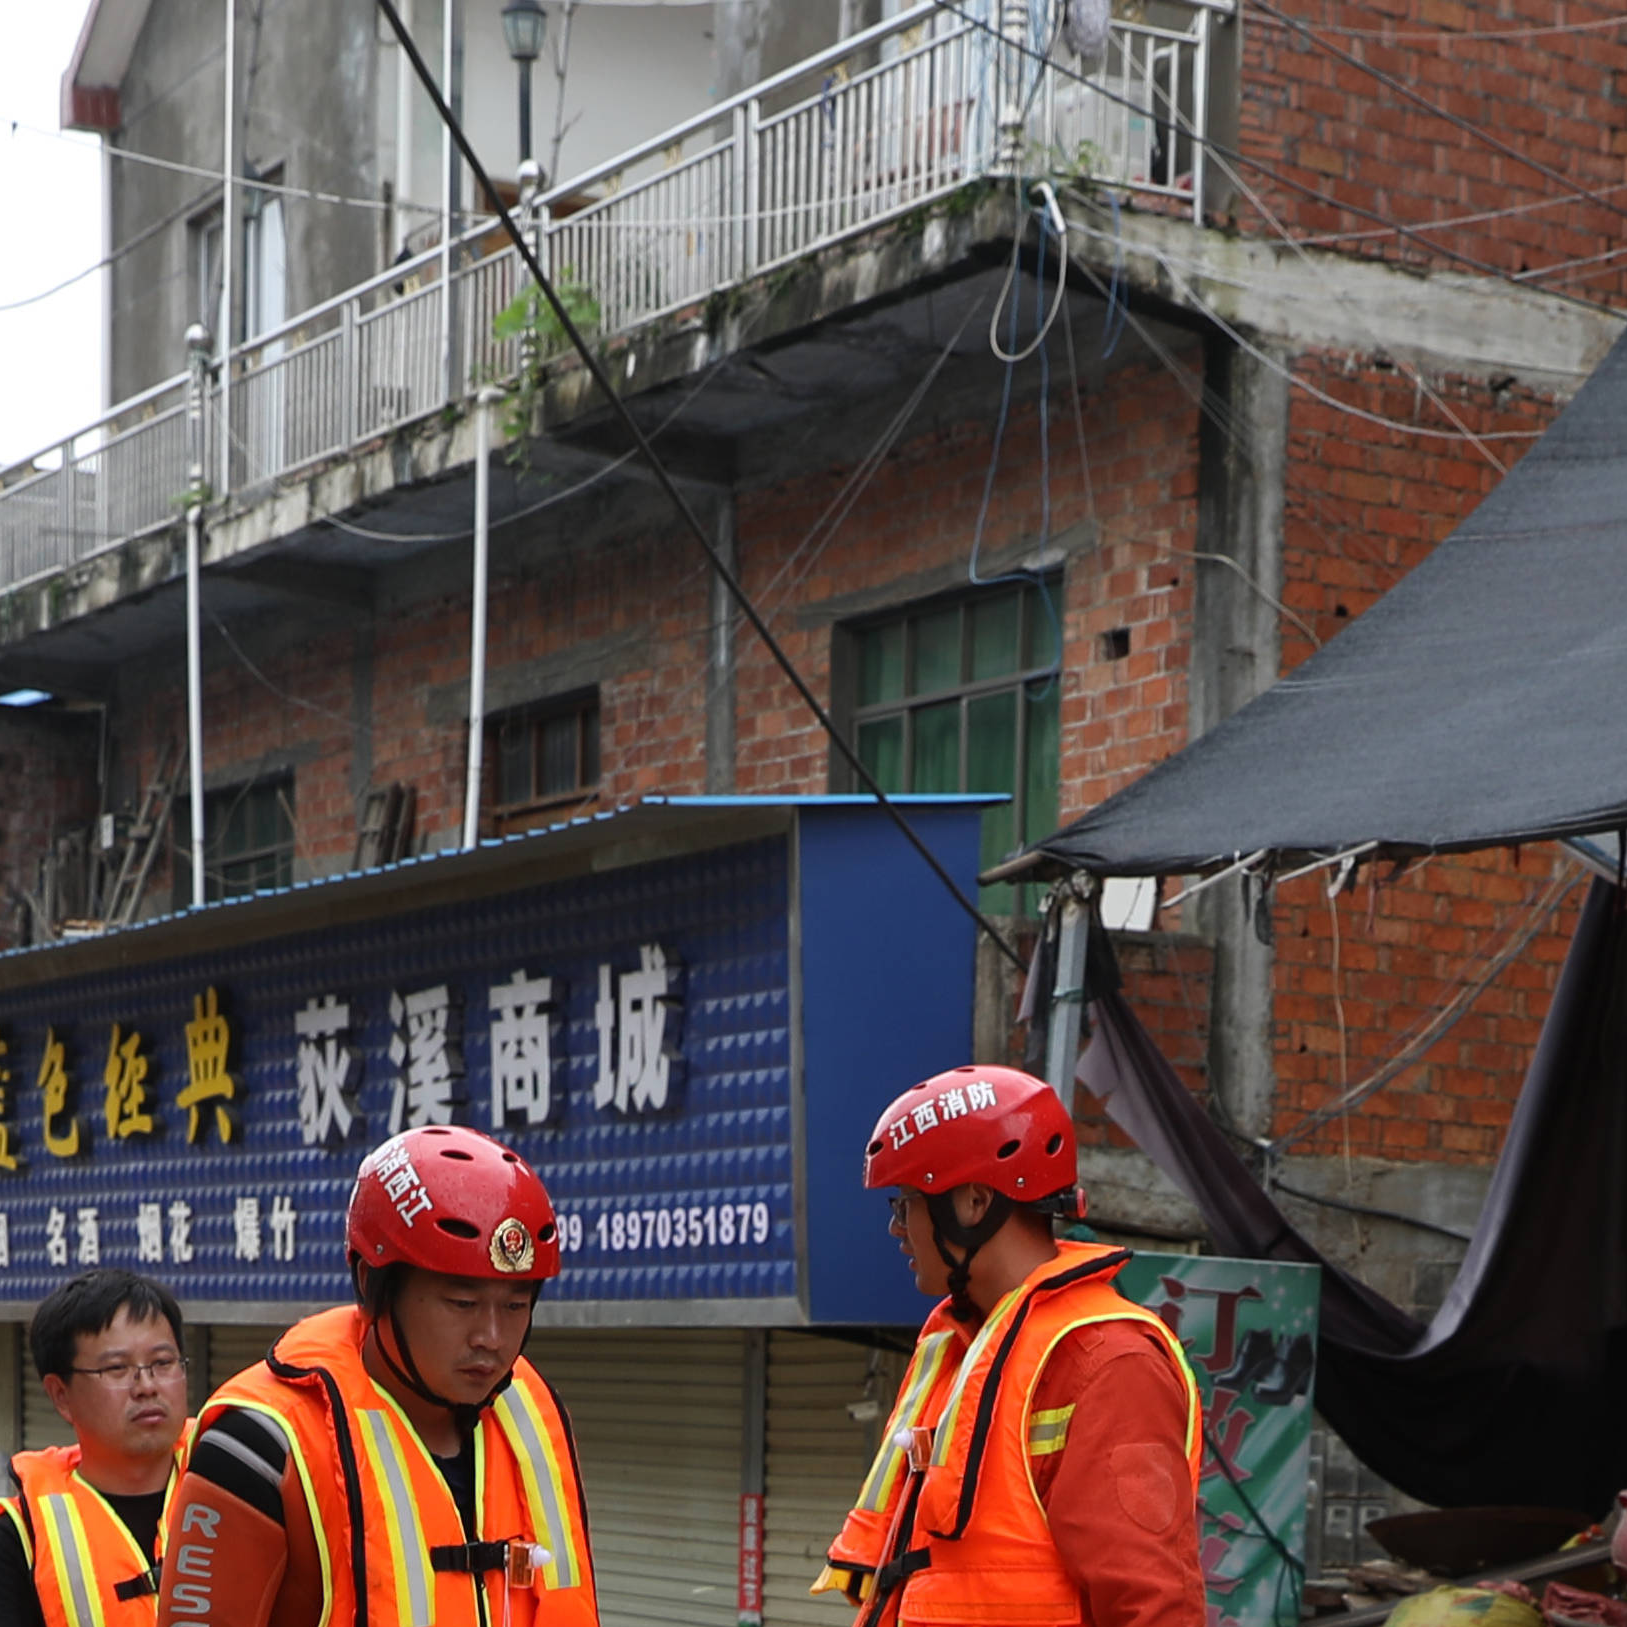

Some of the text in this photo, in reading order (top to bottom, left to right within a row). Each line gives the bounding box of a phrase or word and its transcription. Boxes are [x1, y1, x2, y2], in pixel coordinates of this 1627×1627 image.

[295, 944, 670, 1146] 荻溪商城
[888, 1080, 998, 1151] 江西消防
[46, 1206, 99, 1266] 名酒
[138, 1200, 192, 1263] 烟花
[235, 1196, 296, 1262] 爆竹
[596, 1202, 770, 1251] 18970351879
